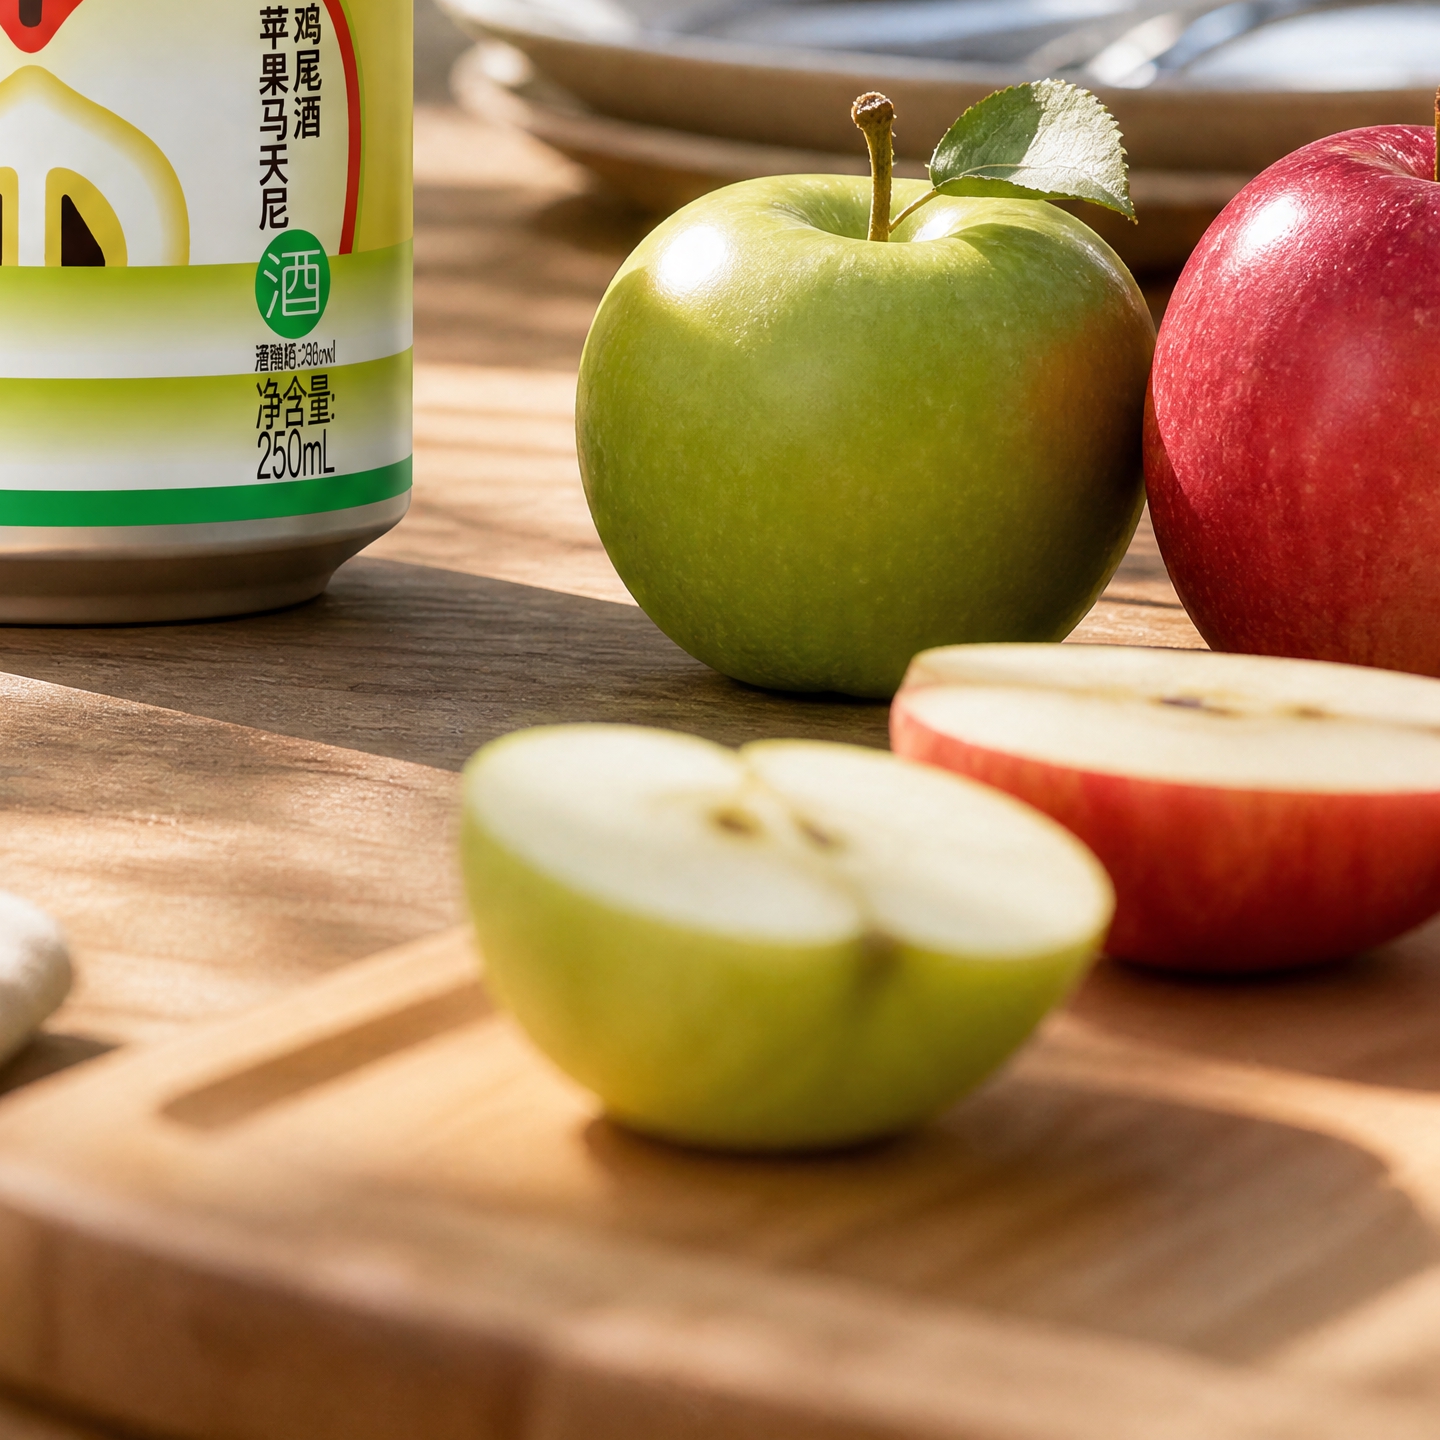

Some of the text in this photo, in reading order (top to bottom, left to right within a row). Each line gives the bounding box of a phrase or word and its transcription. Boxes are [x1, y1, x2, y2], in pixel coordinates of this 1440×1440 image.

[259, 5, 289, 230] 苹果马天尼
[293, 3, 322, 139] 鸡尾酒
[263, 249, 321, 318] 酒
[257, 428, 335, 480] 250mL
